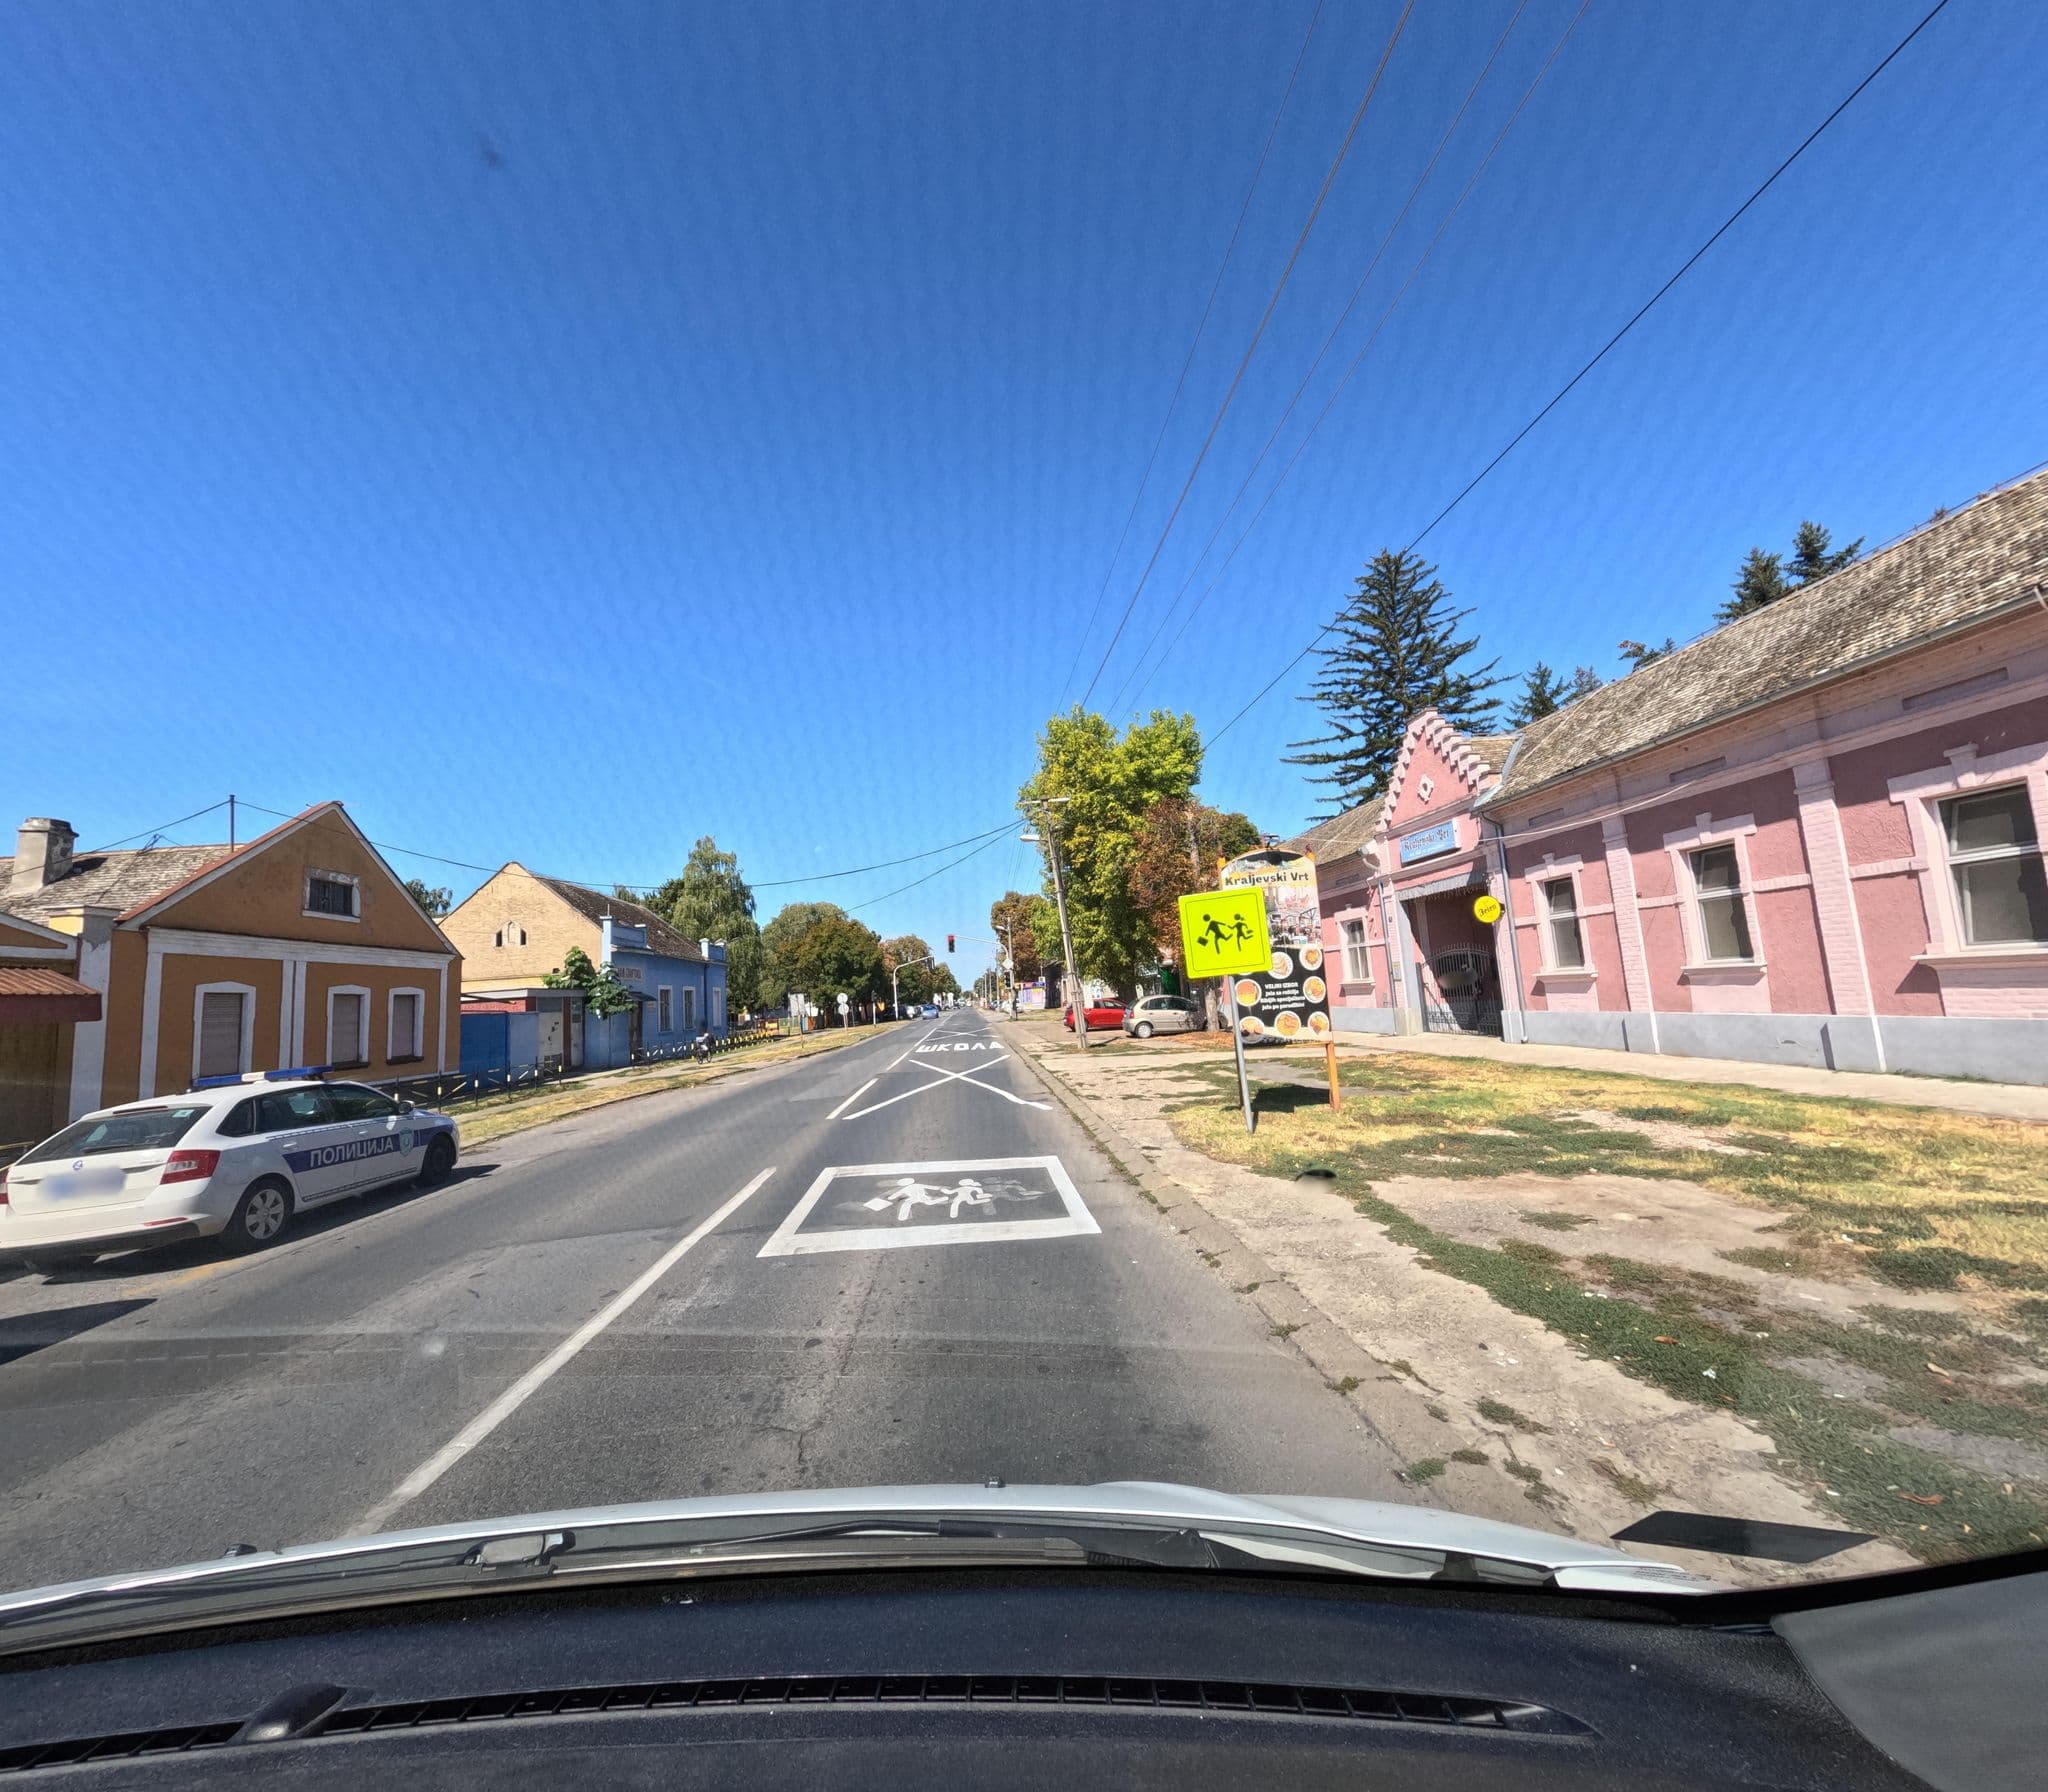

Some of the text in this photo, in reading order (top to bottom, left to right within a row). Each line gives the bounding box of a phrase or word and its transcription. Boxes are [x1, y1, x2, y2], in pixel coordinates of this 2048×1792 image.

[1225, 872, 1309, 886] Kraljevski Vrt
[914, 1041, 1005, 1053] ШКОЛА
[310, 1137, 394, 1168] ПОЛИЦИЈА
